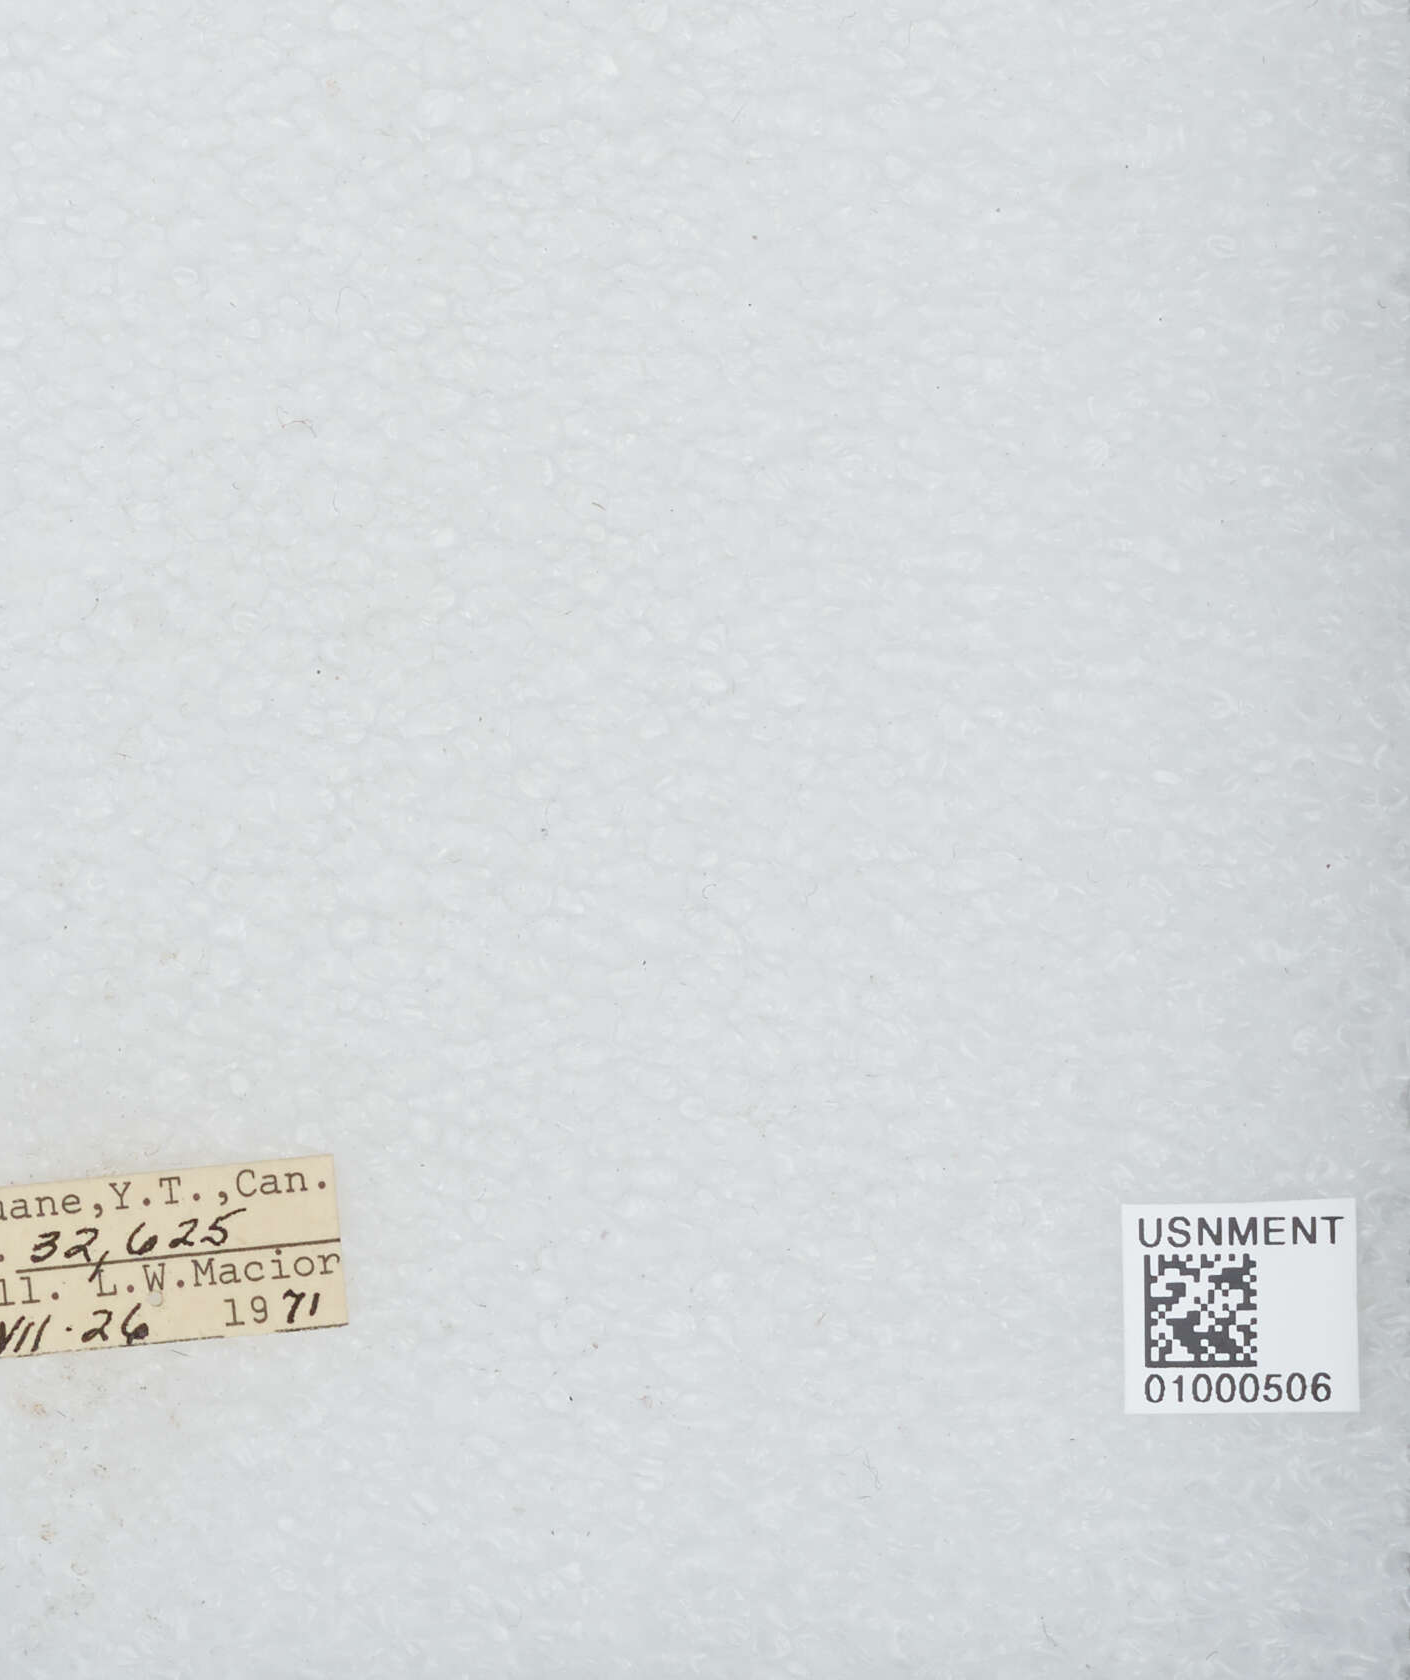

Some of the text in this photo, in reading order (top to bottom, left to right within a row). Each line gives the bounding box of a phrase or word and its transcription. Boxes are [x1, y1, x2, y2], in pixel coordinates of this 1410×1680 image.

[30, 1207, 247, 1282] 32,625
[1138, 1215, 1345, 1249] USNMENT
[224, 1288, 321, 1328] 1971
[1143, 1371, 1333, 1403] 01000506
